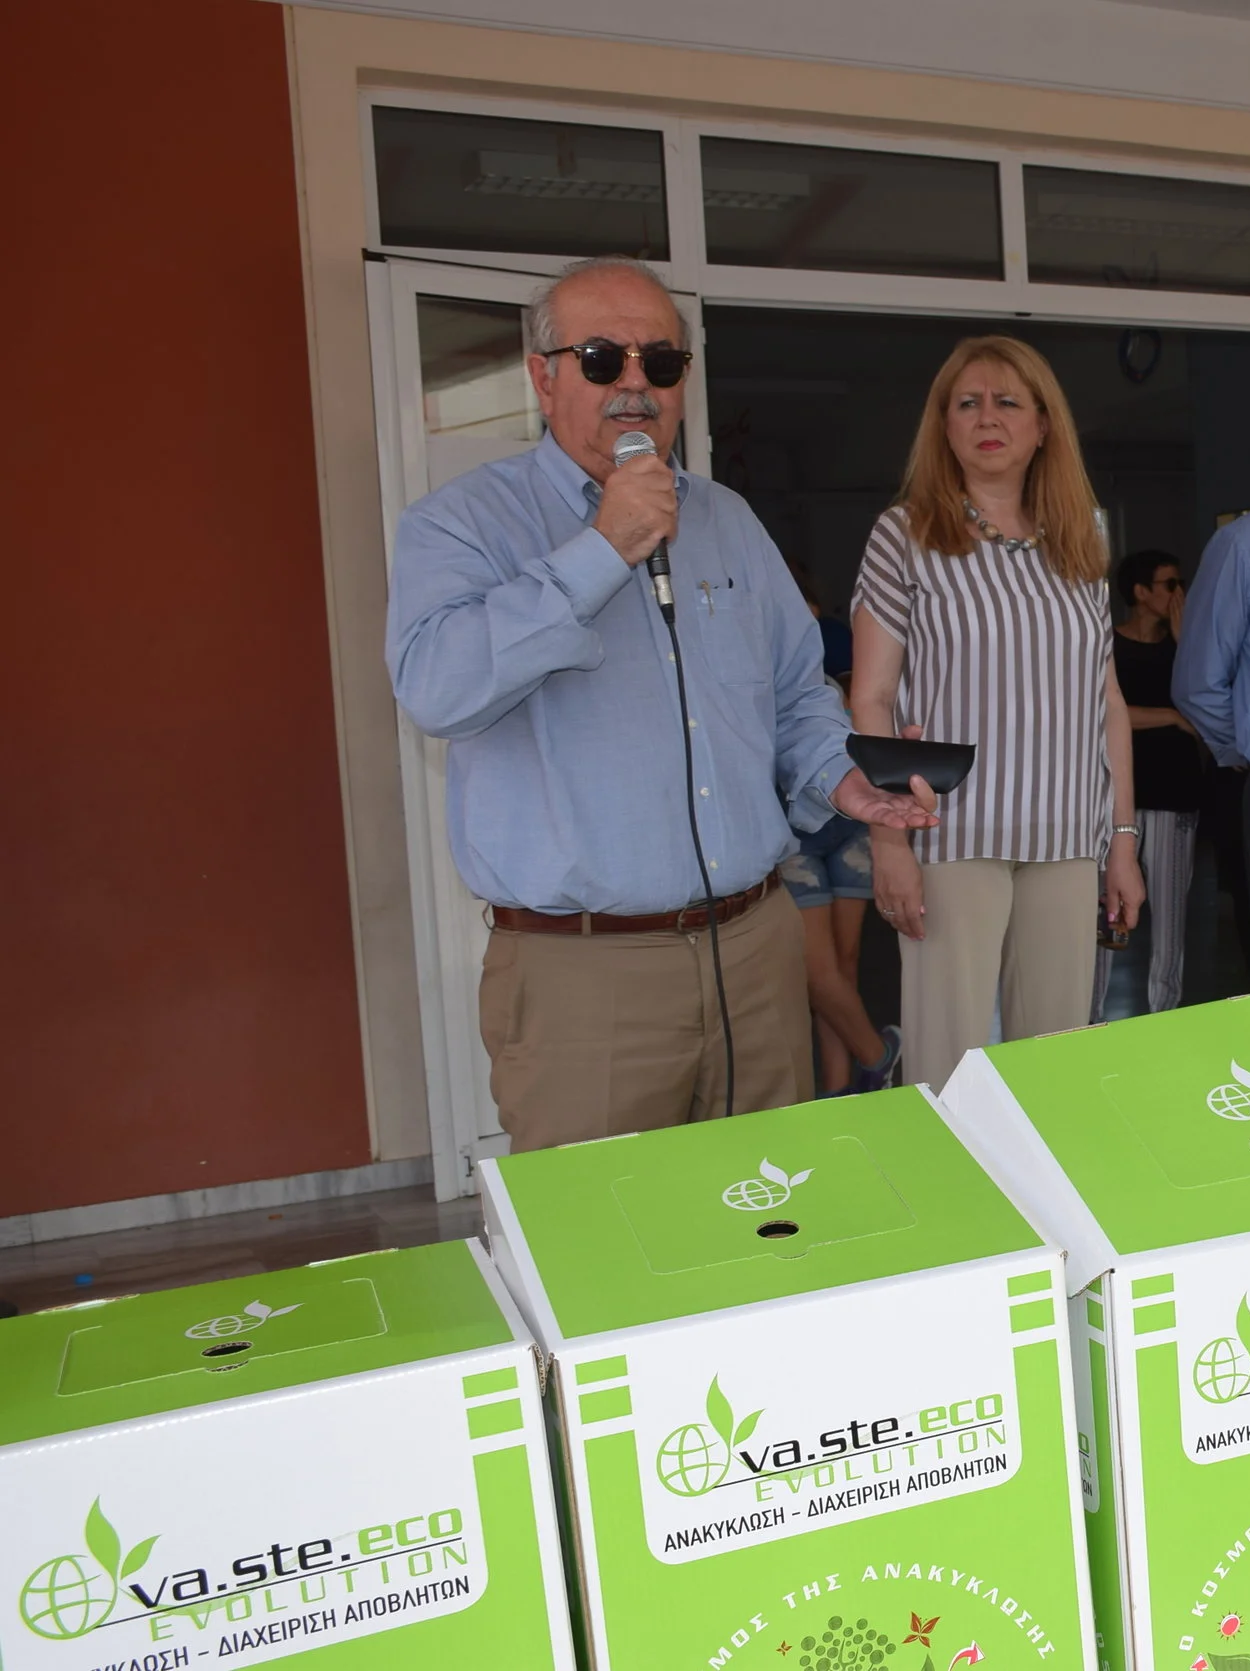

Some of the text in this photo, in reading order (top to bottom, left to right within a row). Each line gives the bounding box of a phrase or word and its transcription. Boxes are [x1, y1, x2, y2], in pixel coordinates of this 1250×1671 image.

[739, 1393, 1003, 1473] va.ste.eco
[755, 1425, 1007, 1502] EVOLUTION
[664, 1507, 785, 1552] ΑΝΑΚΥΚΛΩΣΗ
[807, 1479, 901, 1517] ΔΙΑΧΕΙΡΙΣΗ
[906, 1453, 1007, 1493] ΑΠΟΒΛΗΤΩΝ
[129, 1508, 463, 1608] va.ste.eco
[150, 1542, 468, 1641] EVOLUTION
[218, 1609, 337, 1657] ΔΙΑΧΕΙΡΙΣΗ
[343, 1576, 471, 1625] ΑΠΟΒΛΗΤΩΝ
[782, 1573, 842, 1609] ΤΗΣ
[860, 1562, 1056, 1660] ΑΝΑΚΥΚΛΩΣΗΣ
[1178, 1635, 1194, 1651] Ο
